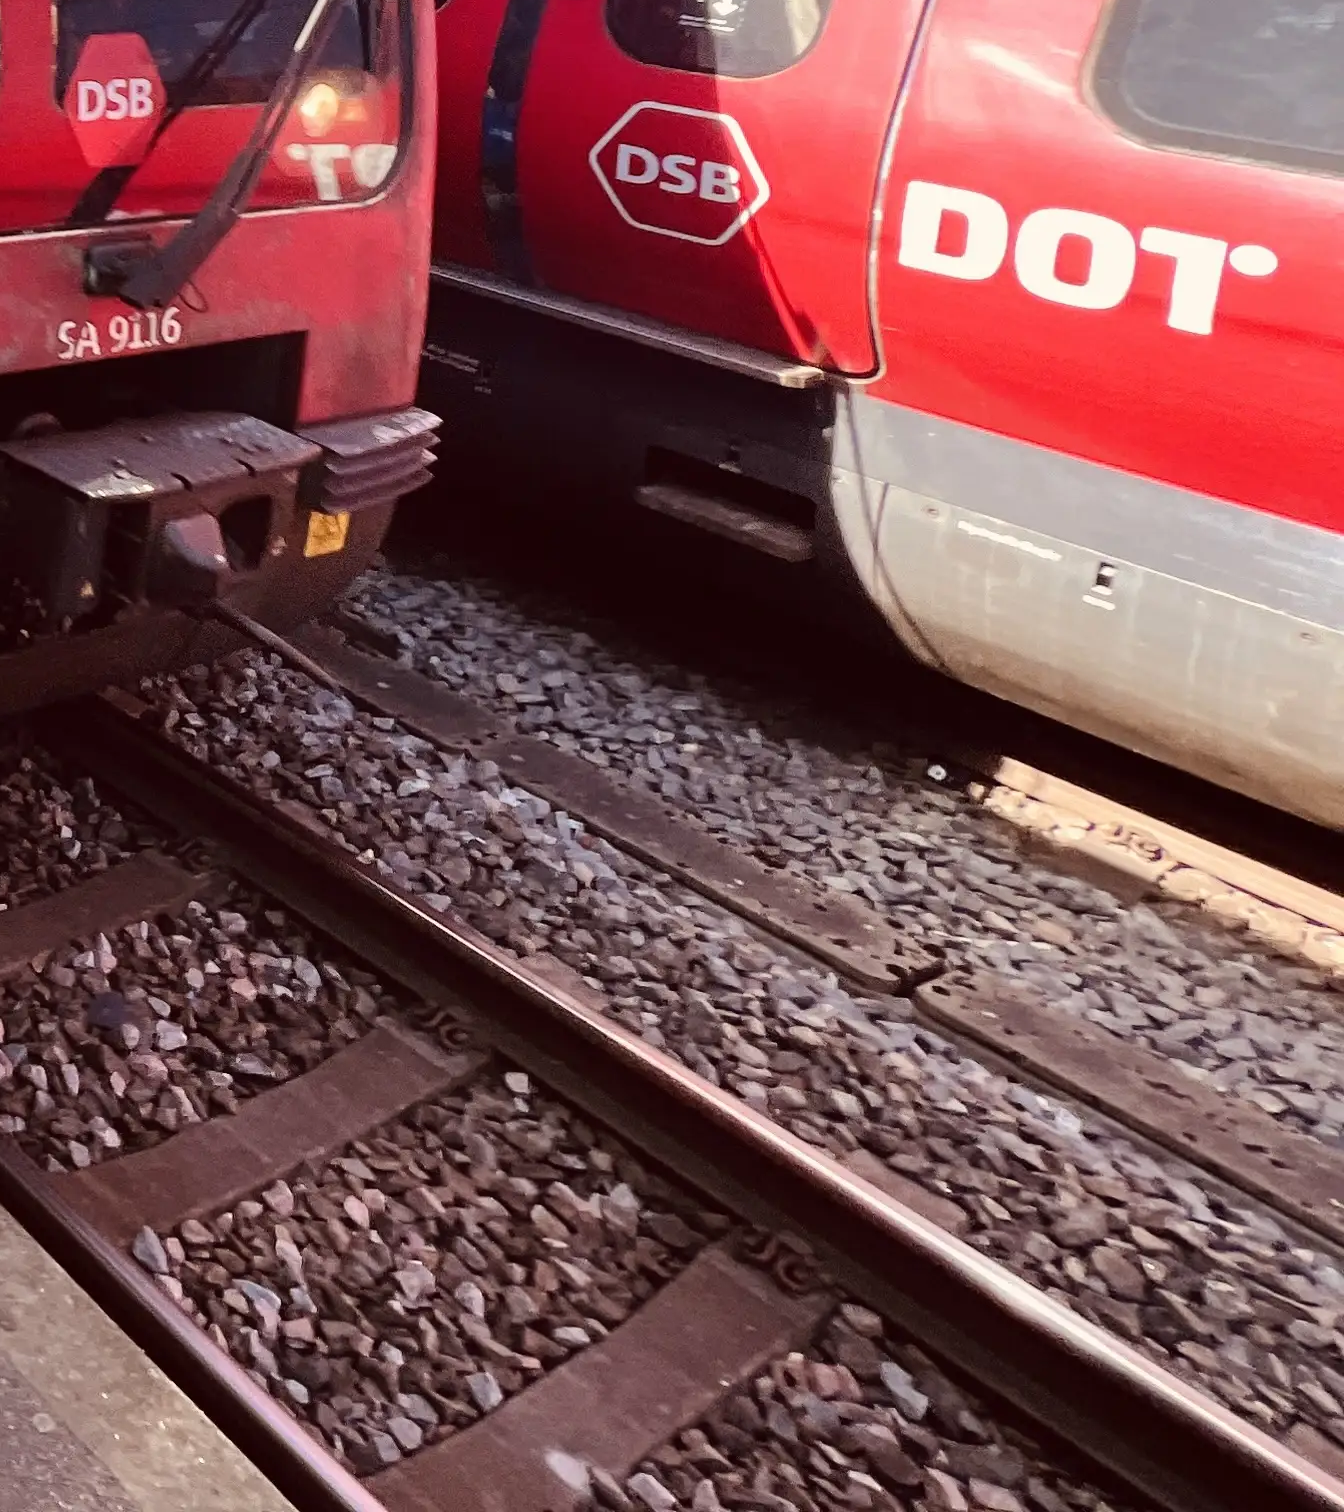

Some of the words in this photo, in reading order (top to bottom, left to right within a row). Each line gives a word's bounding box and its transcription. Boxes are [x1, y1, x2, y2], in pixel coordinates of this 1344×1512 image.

[77, 78, 155, 122] DSB
[614, 143, 742, 205] DSB
[897, 179, 1278, 336] DOT
[57, 320, 102, 360] SA
[109, 306, 183, 353] 9116
